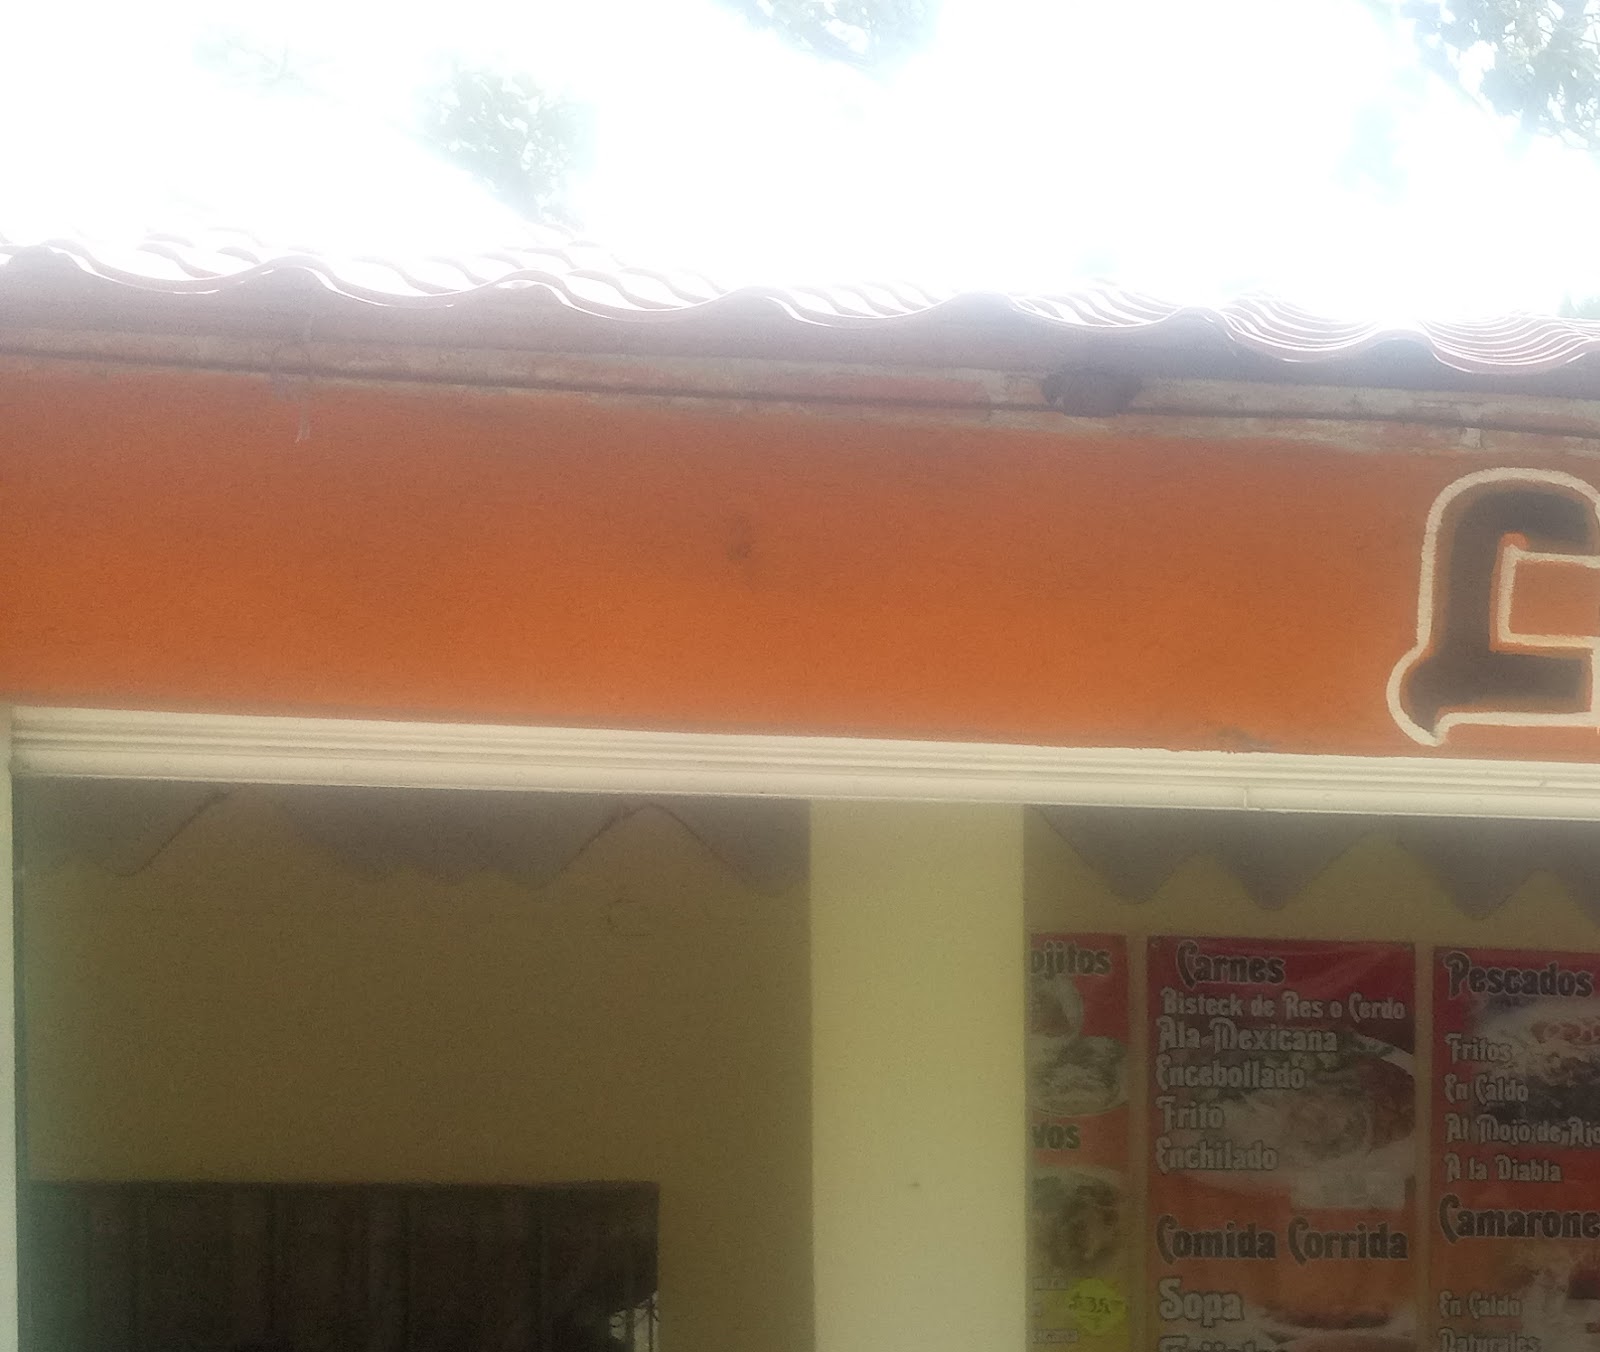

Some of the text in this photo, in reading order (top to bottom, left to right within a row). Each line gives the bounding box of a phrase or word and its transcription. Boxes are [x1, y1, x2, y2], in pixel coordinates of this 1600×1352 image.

[1176, 939, 1286, 990] Carnes
[1444, 950, 1594, 1000] Pescados
[1160, 986, 1407, 1023] Bisteck de Res o Cerdo
[1208, 1016, 1338, 1053] Mexicana
[1444, 1033, 1513, 1064] Fritos
[1156, 1053, 1306, 1090] Encebollado
[1444, 1073, 1529, 1105] En Caldo
[1156, 1095, 1225, 1133] Frito
[1444, 1113, 1469, 1145] Al
[1478, 1114, 1532, 1145] Mojo
[1156, 1136, 1279, 1175] Enchilado
[1444, 1153, 1563, 1183] A la Diabla
[1156, 1214, 1409, 1265] Comida Corrida
[1158, 1276, 1244, 1328] Sopa
